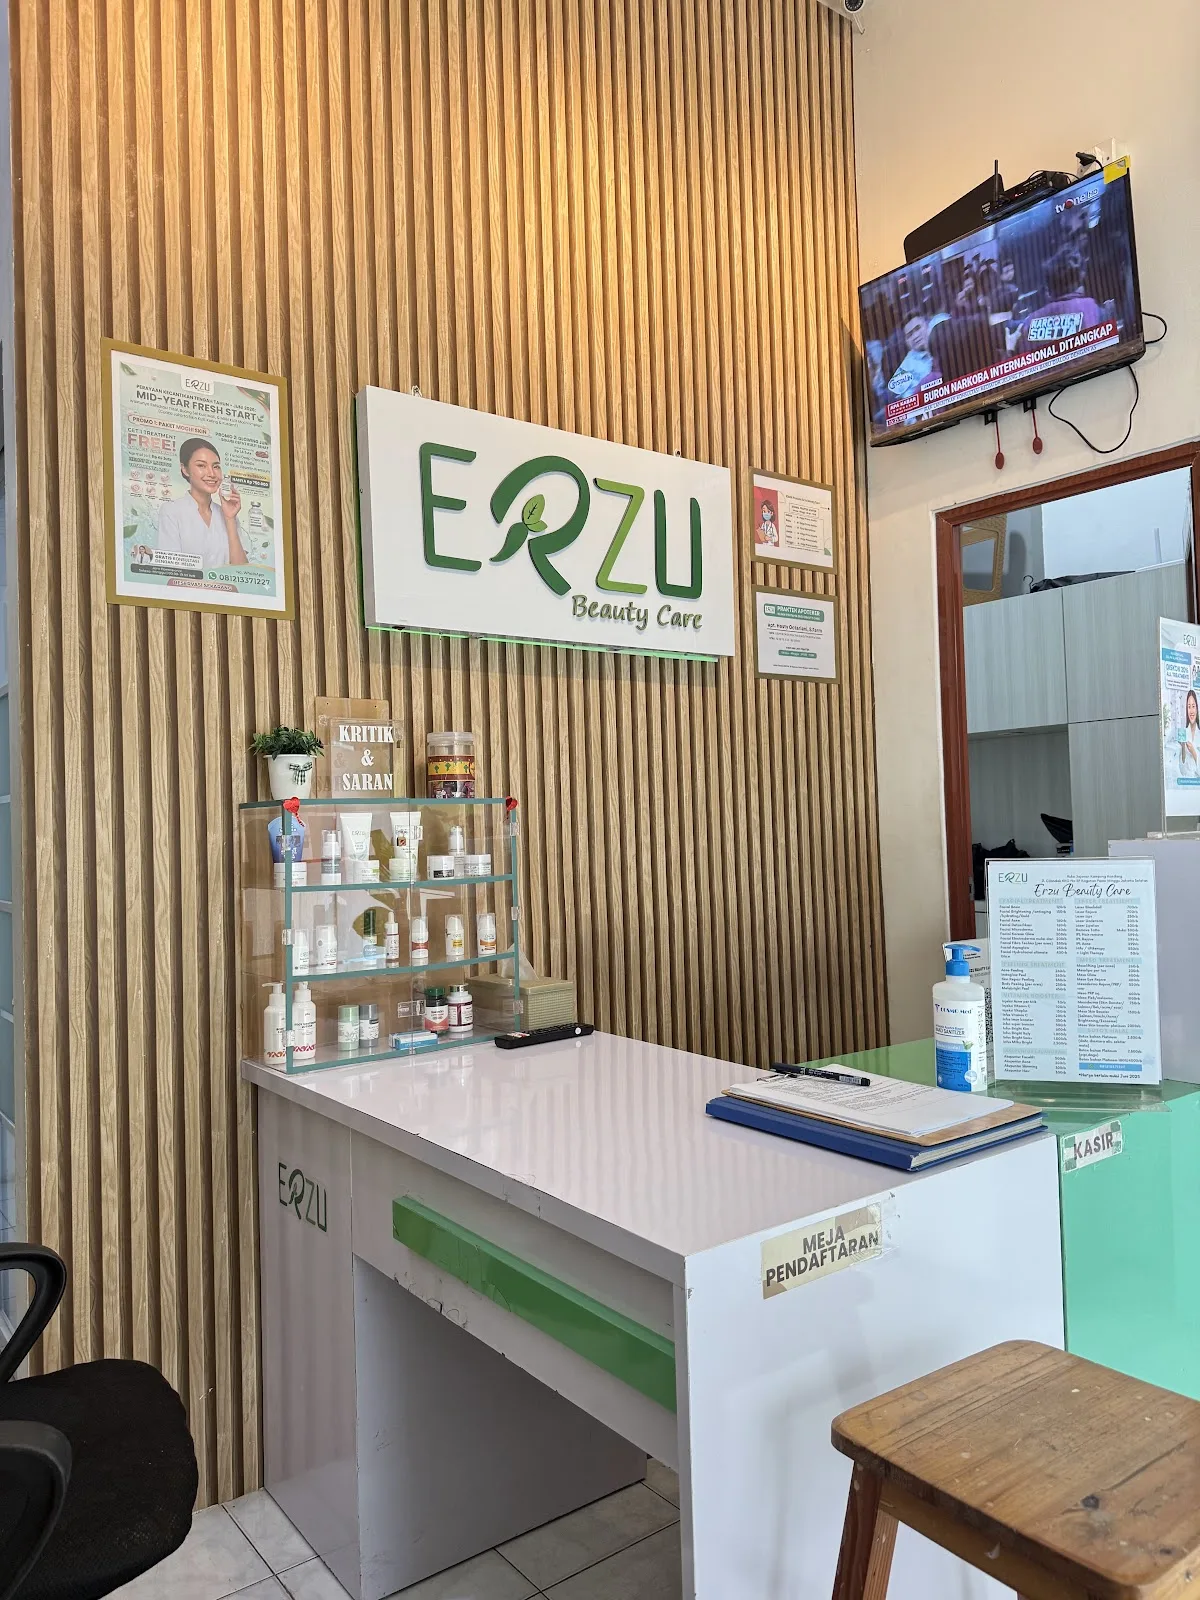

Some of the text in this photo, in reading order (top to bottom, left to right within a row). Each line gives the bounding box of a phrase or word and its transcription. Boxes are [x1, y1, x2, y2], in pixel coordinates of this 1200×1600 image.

[924, 324, 1113, 403] BURON NARKOBA INTERNASIONAL DITANGKAP
[185, 378, 210, 392] ERZU
[136, 390, 190, 408] MID-YEAR
[192, 402, 223, 414] FRESH
[226, 408, 256, 420] START
[132, 416, 154, 424] PROMO
[128, 433, 176, 452] FREE!
[144, 430, 176, 440] TREATMENT
[418, 441, 703, 599] ERZU
[219, 574, 270, 585] 081213371227
[571, 594, 703, 631] Beauty Care
[339, 724, 394, 743] KRITIK
[361, 749, 375, 766] &
[342, 774, 394, 791] SARAN
[998, 872, 1028, 884] ERZU
[1034, 882, 1132, 898] Erzu Beauty Care
[1073, 1131, 1114, 1161] KASIR
[278, 1162, 328, 1232] ERZU
[802, 1226, 845, 1255] MEJA
[766, 1230, 879, 1287] PENDAFTARAN
